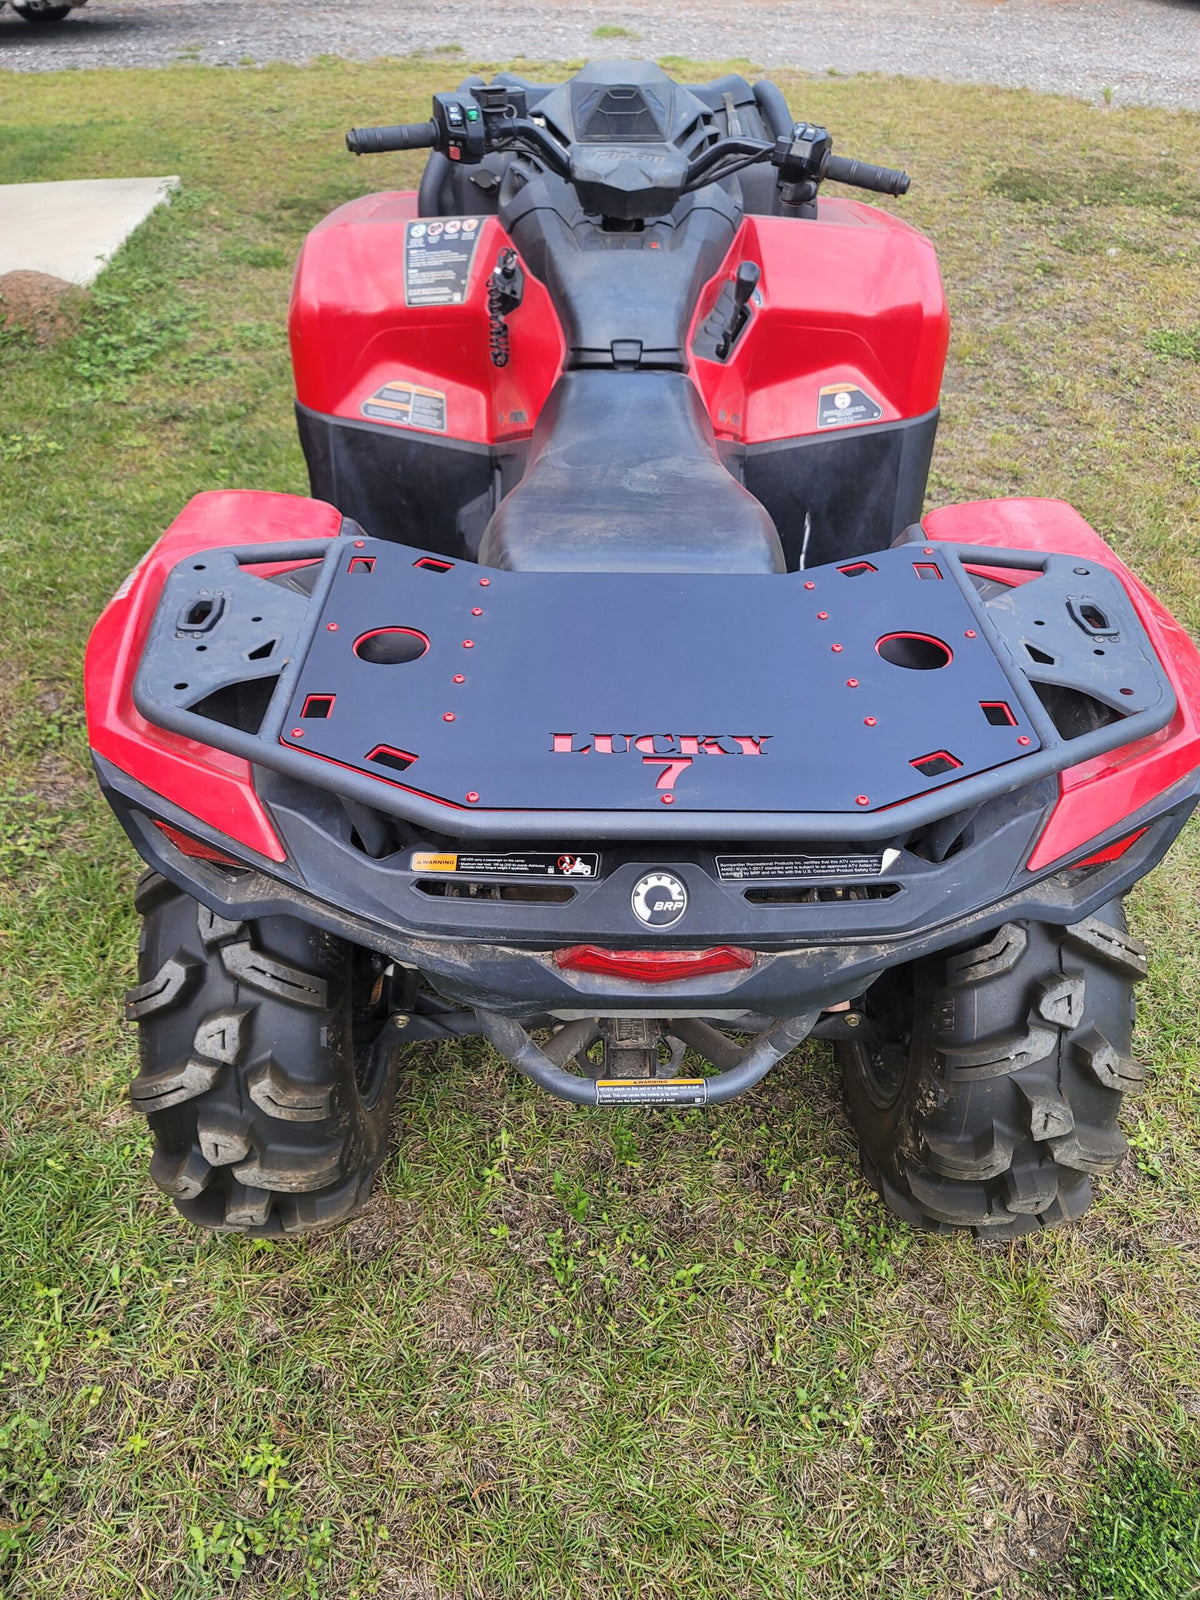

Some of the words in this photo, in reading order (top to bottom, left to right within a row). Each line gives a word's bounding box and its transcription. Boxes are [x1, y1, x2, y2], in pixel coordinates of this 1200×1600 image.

[549, 732, 774, 755] LUCKY
[642, 756, 693, 790] 7
[653, 901, 684, 911] BRP
